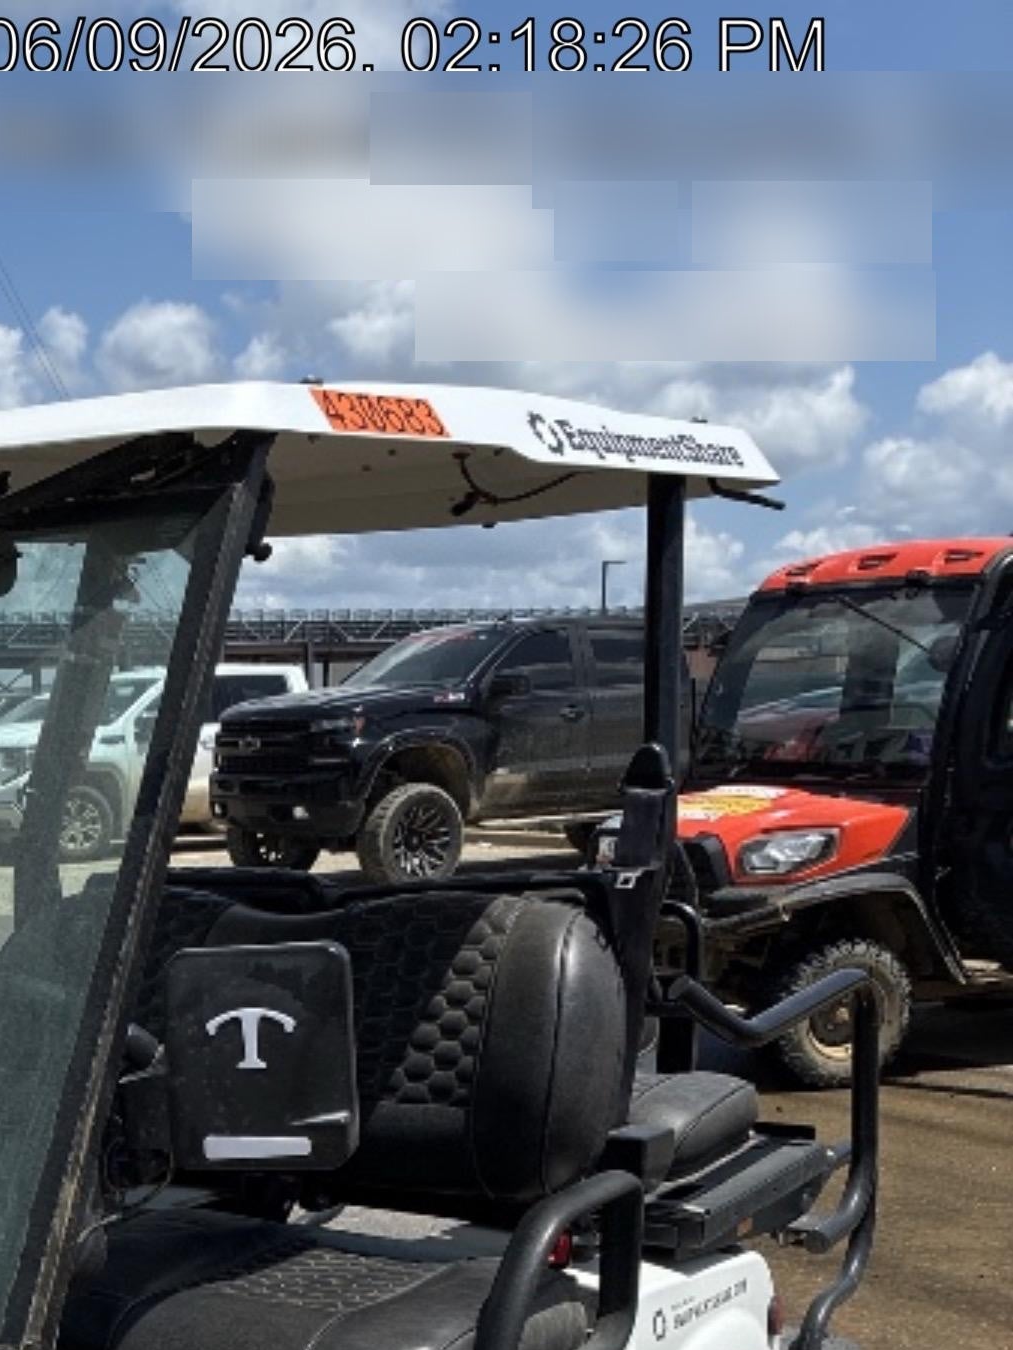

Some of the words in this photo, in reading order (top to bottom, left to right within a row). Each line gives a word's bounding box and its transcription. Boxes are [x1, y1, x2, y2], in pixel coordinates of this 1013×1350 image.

[321, 390, 445, 435] 430683
[554, 418, 745, 467] EquipmentShare
[205, 1006, 297, 1070] T
